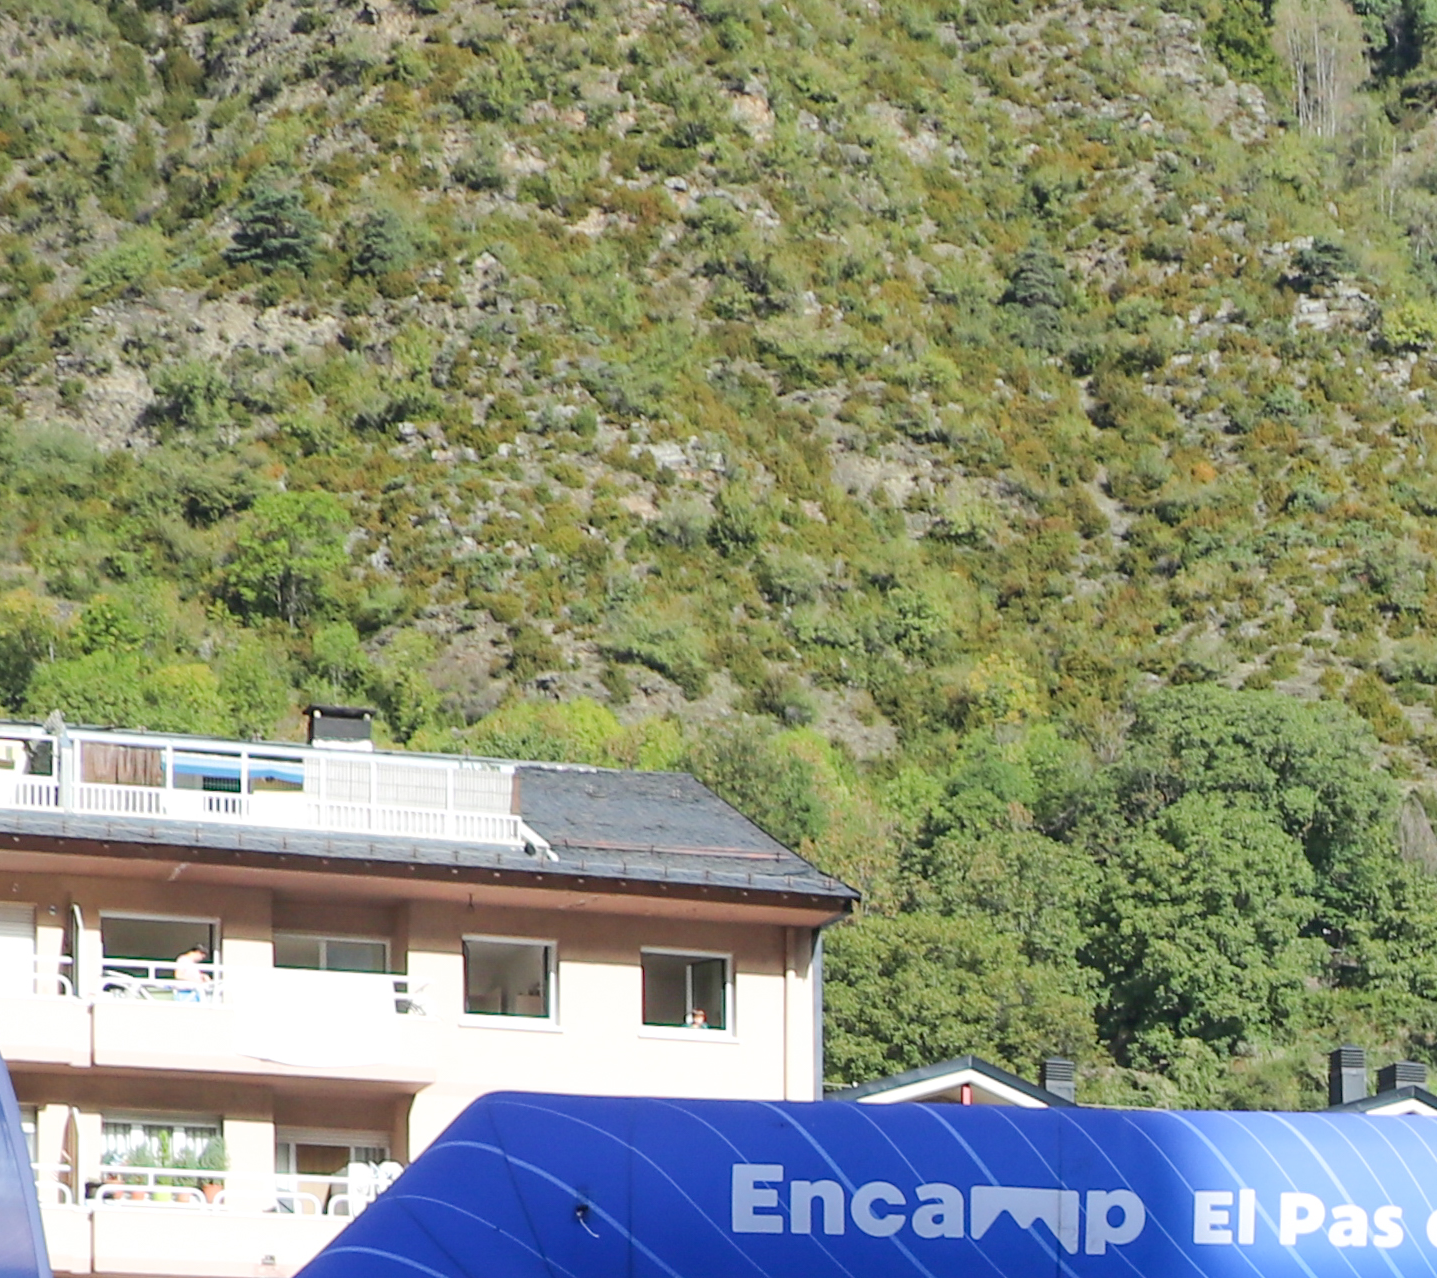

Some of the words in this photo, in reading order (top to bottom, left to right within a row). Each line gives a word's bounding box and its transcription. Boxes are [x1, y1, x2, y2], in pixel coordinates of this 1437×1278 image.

[731, 1164, 1145, 1256] Encamp
[1193, 1188, 1255, 1245] El
[1279, 1192, 1404, 1250] Pas
